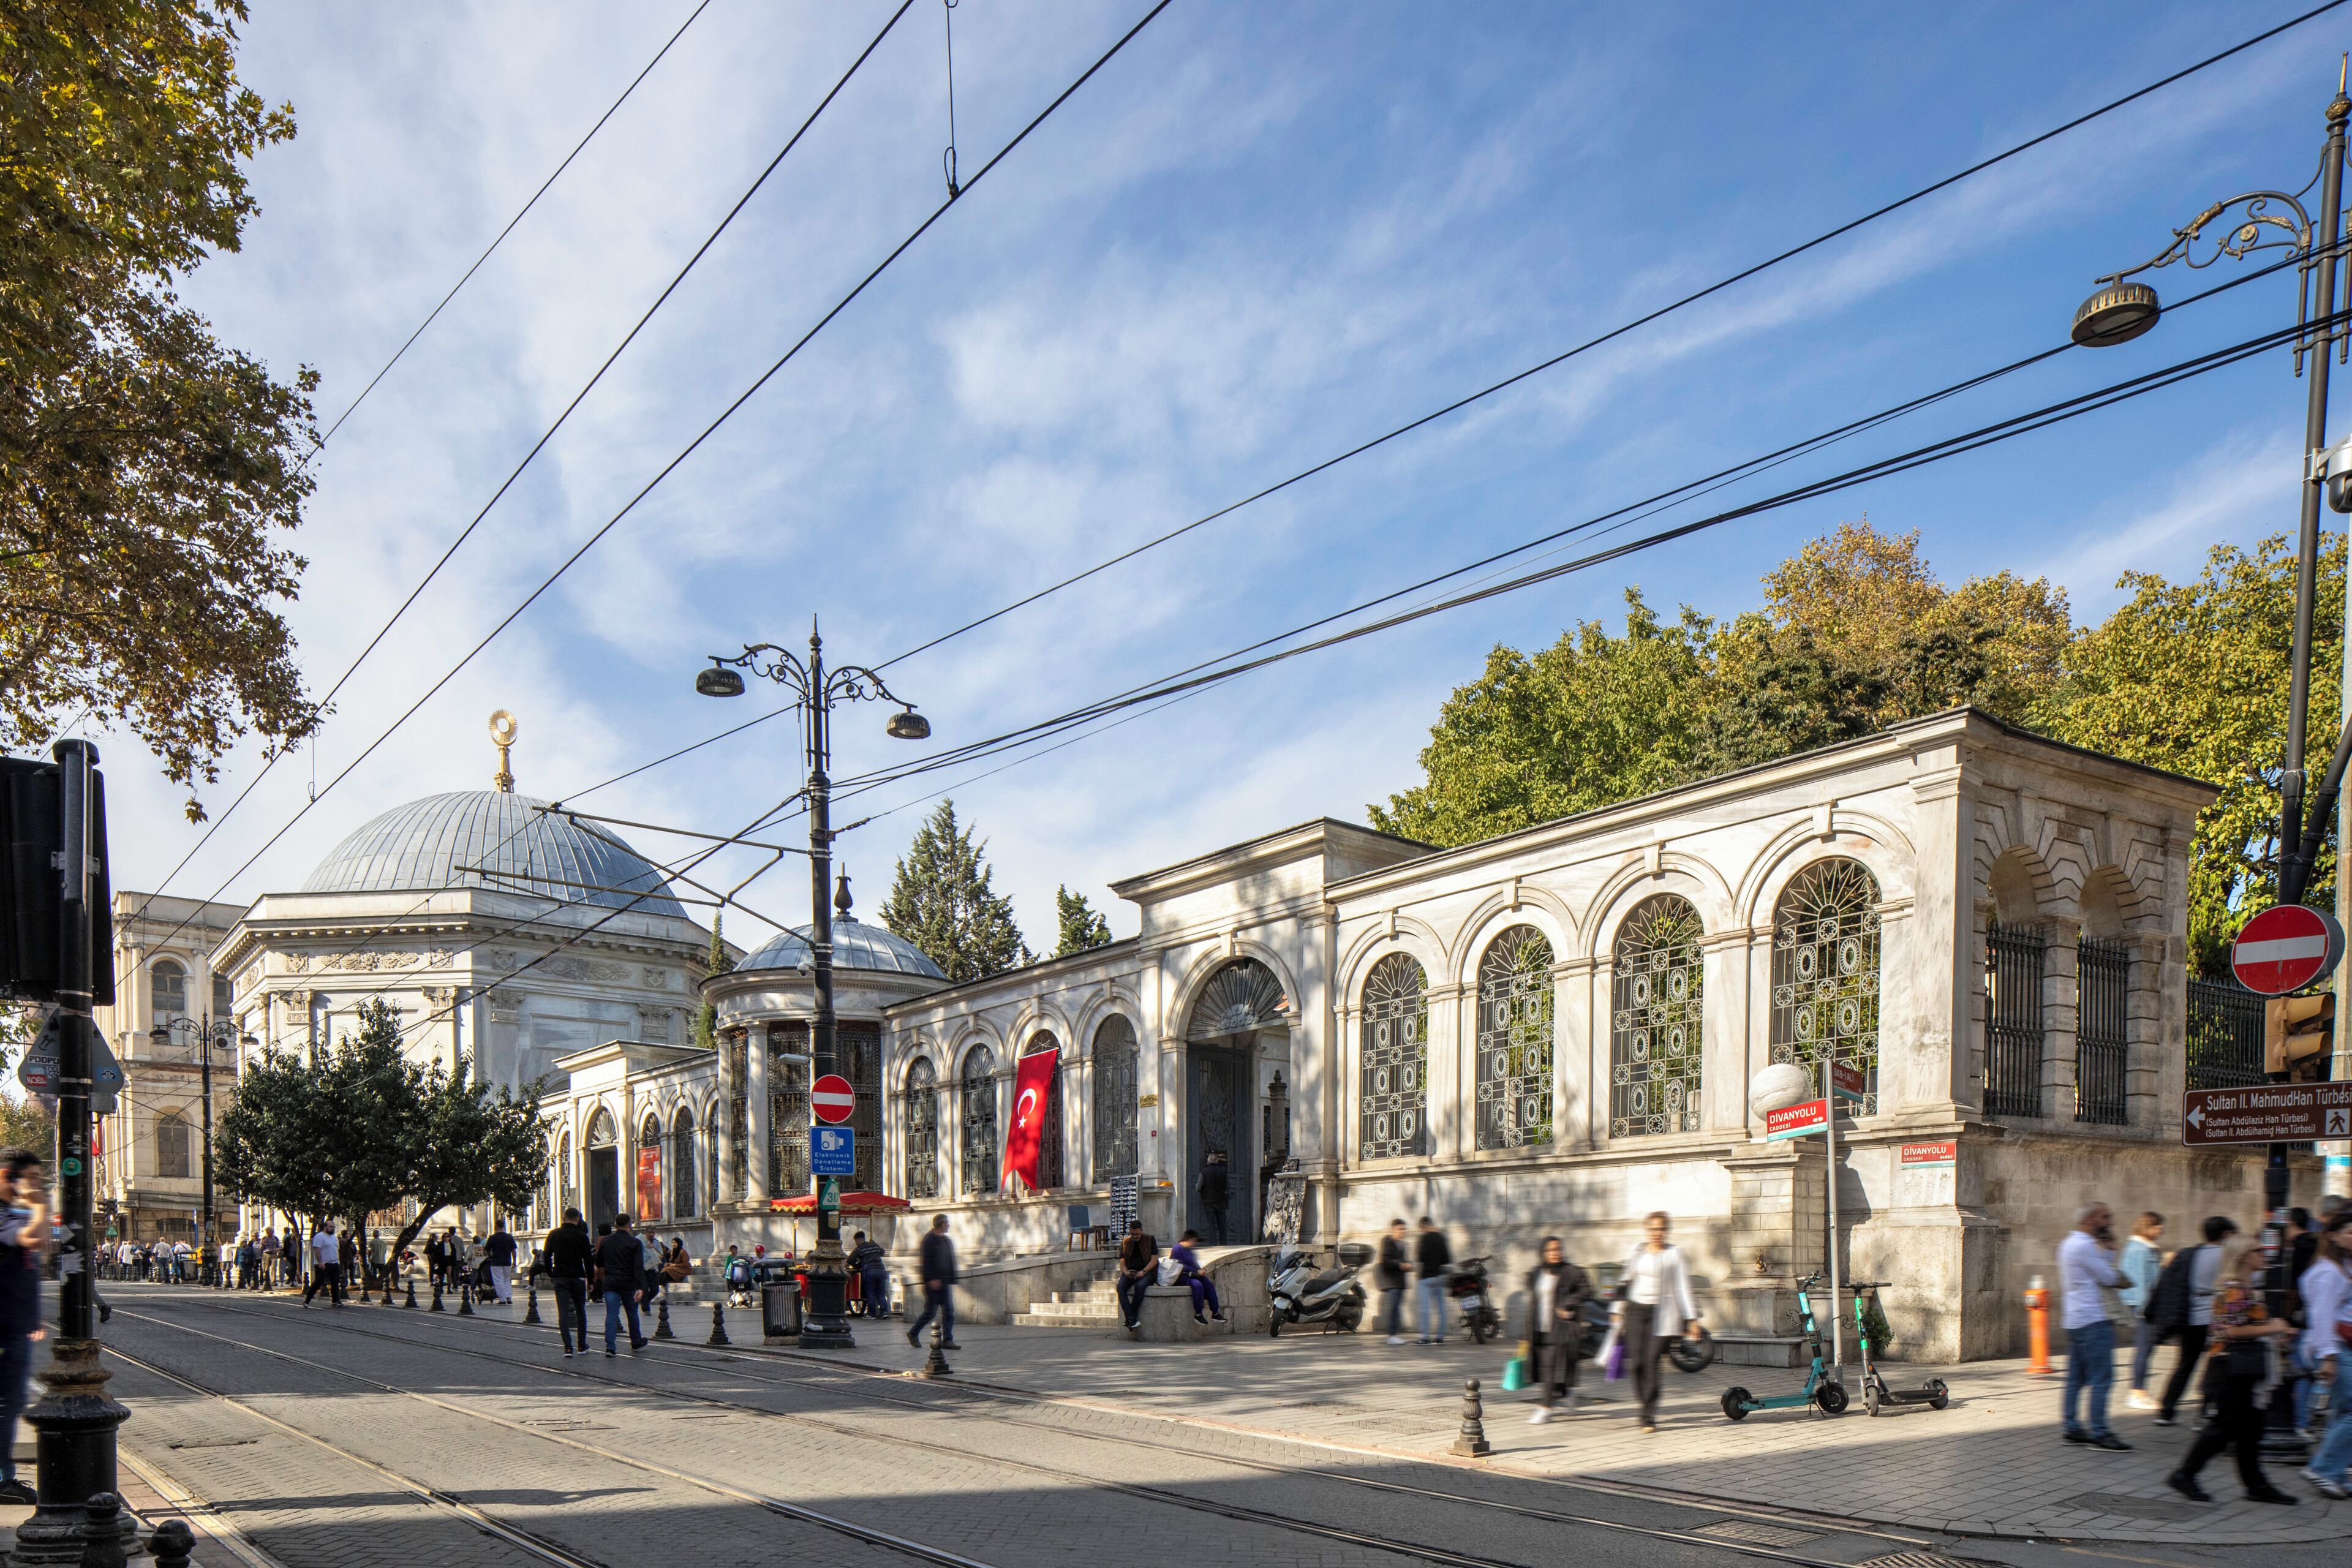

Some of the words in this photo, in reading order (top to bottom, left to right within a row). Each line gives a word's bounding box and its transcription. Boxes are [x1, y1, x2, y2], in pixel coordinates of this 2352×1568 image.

[2207, 1095, 2237, 1110] Sultan
[2239, 1093, 2248, 1109] II.
[2316, 1088, 2352, 1105] Türbesi
[1770, 1106, 1817, 1125] DİVANYOLU
[2206, 1118, 2230, 1127] (Sultan
[2231, 1115, 2264, 1126] Abdülaziz
[2265, 1114, 2279, 1124] Han
[2280, 1112, 2309, 1123] Türbesi)
[1769, 1122, 1791, 1132] CADDESİ
[2206, 1128, 2227, 1137] (Sultan
[2275, 1126, 2288, 1134] Han
[2290, 1124, 2315, 1134] Türbesi)
[1904, 1146, 1947, 1156] DİVANYOLU
[827, 1192, 839, 1203] 30
